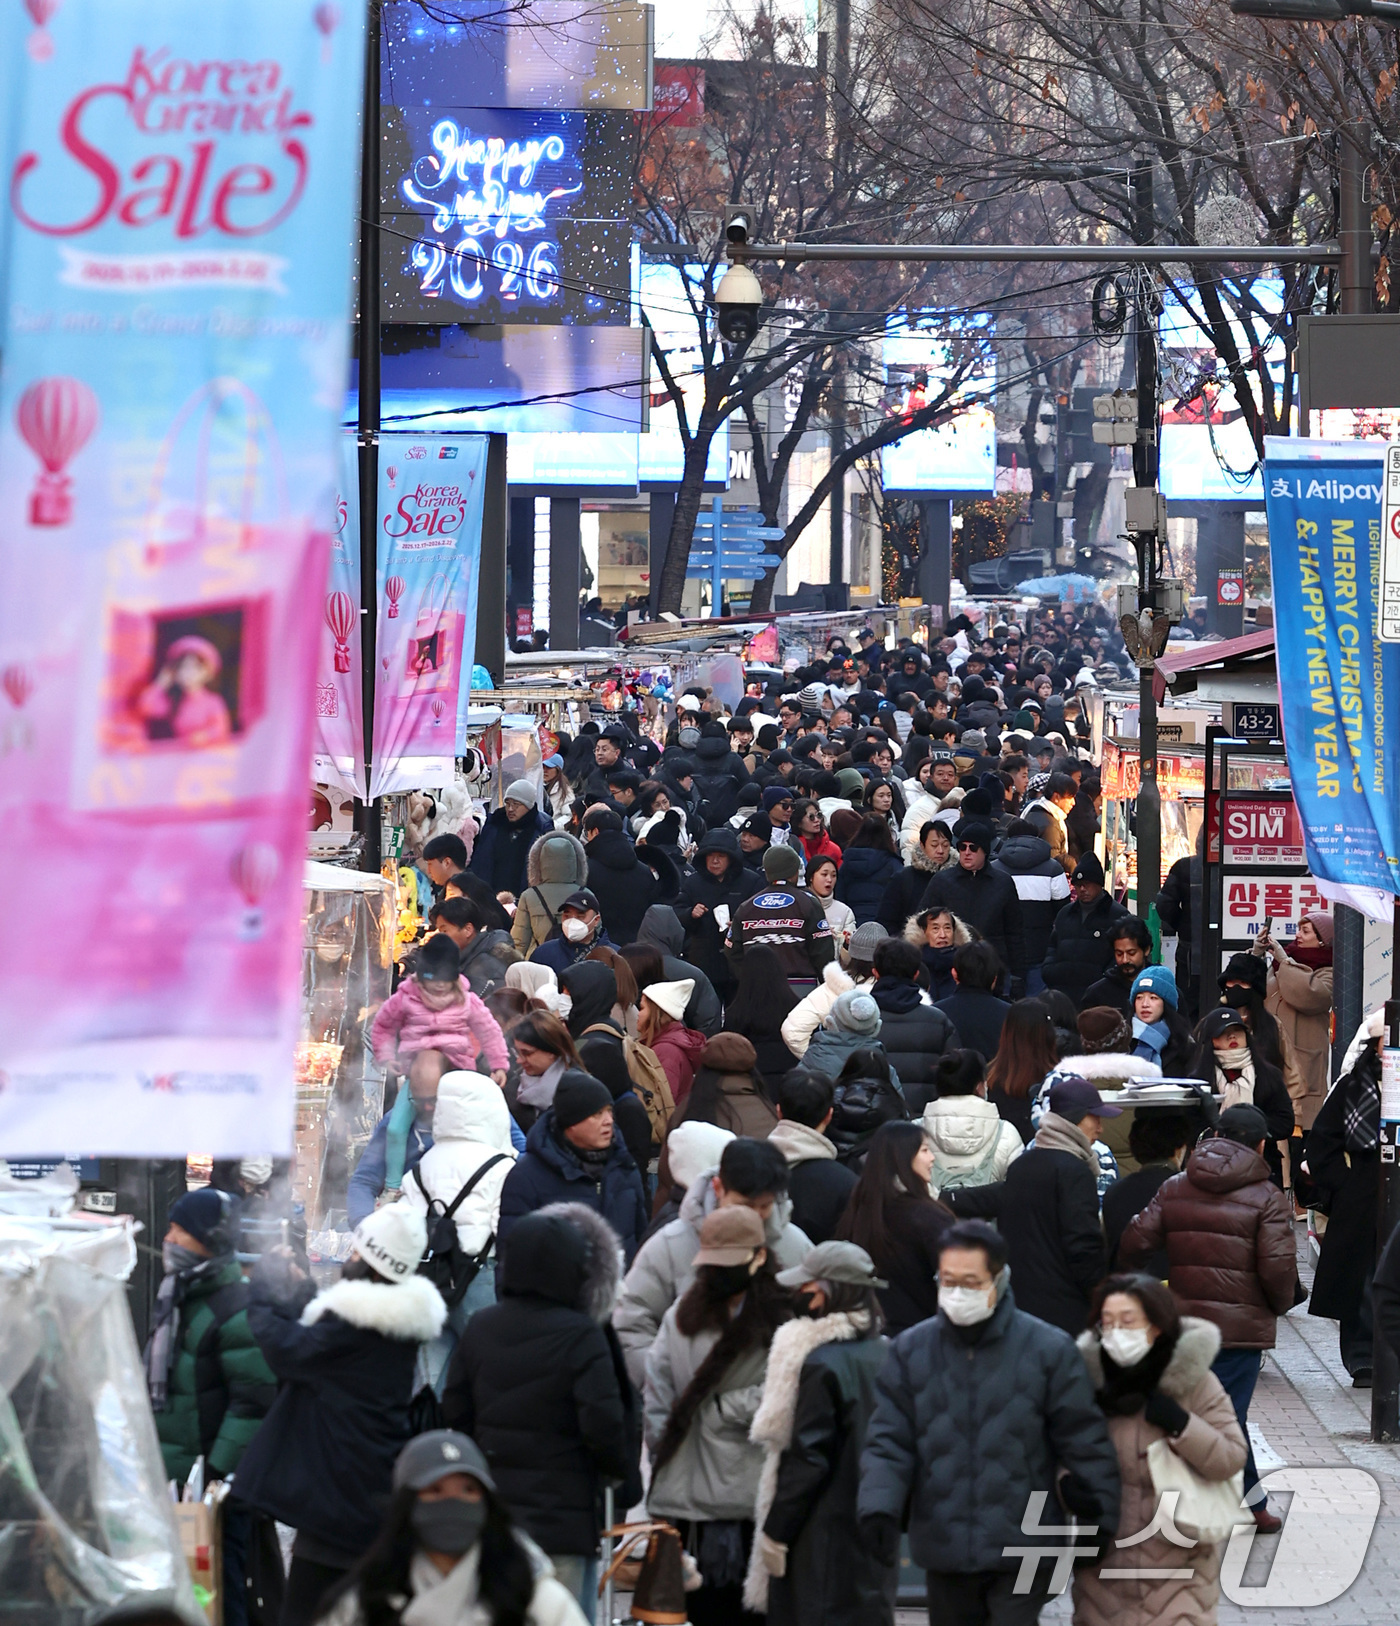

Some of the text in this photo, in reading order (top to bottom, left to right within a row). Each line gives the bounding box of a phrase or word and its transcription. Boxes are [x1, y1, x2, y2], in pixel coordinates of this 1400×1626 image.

[127, 46, 283, 97] Korea
[10, 83, 311, 241] Sale
[414, 119, 564, 190] Happy
[412, 237, 559, 300] 2026
[415, 483, 459, 497] Korea
[416, 493, 466, 508] Grand
[1305, 479, 1384, 503] Alipay
[383, 494, 465, 538] Sale
[1331, 519, 1359, 619] MERRY
[1296, 517, 1340, 798] & HAPPY NEW YEAR
[1372, 639, 1384, 746] MYEONGDONG
[1238, 714, 1274, 729] 43-2
[1373, 750, 1385, 796] EVENT
[1227, 812, 1284, 839] SIM
[761, 895, 787, 905] Ford
[1228, 883, 1328, 917] 상품권
[741, 919, 804, 930] RACING
[366, 1237, 408, 1274] king
